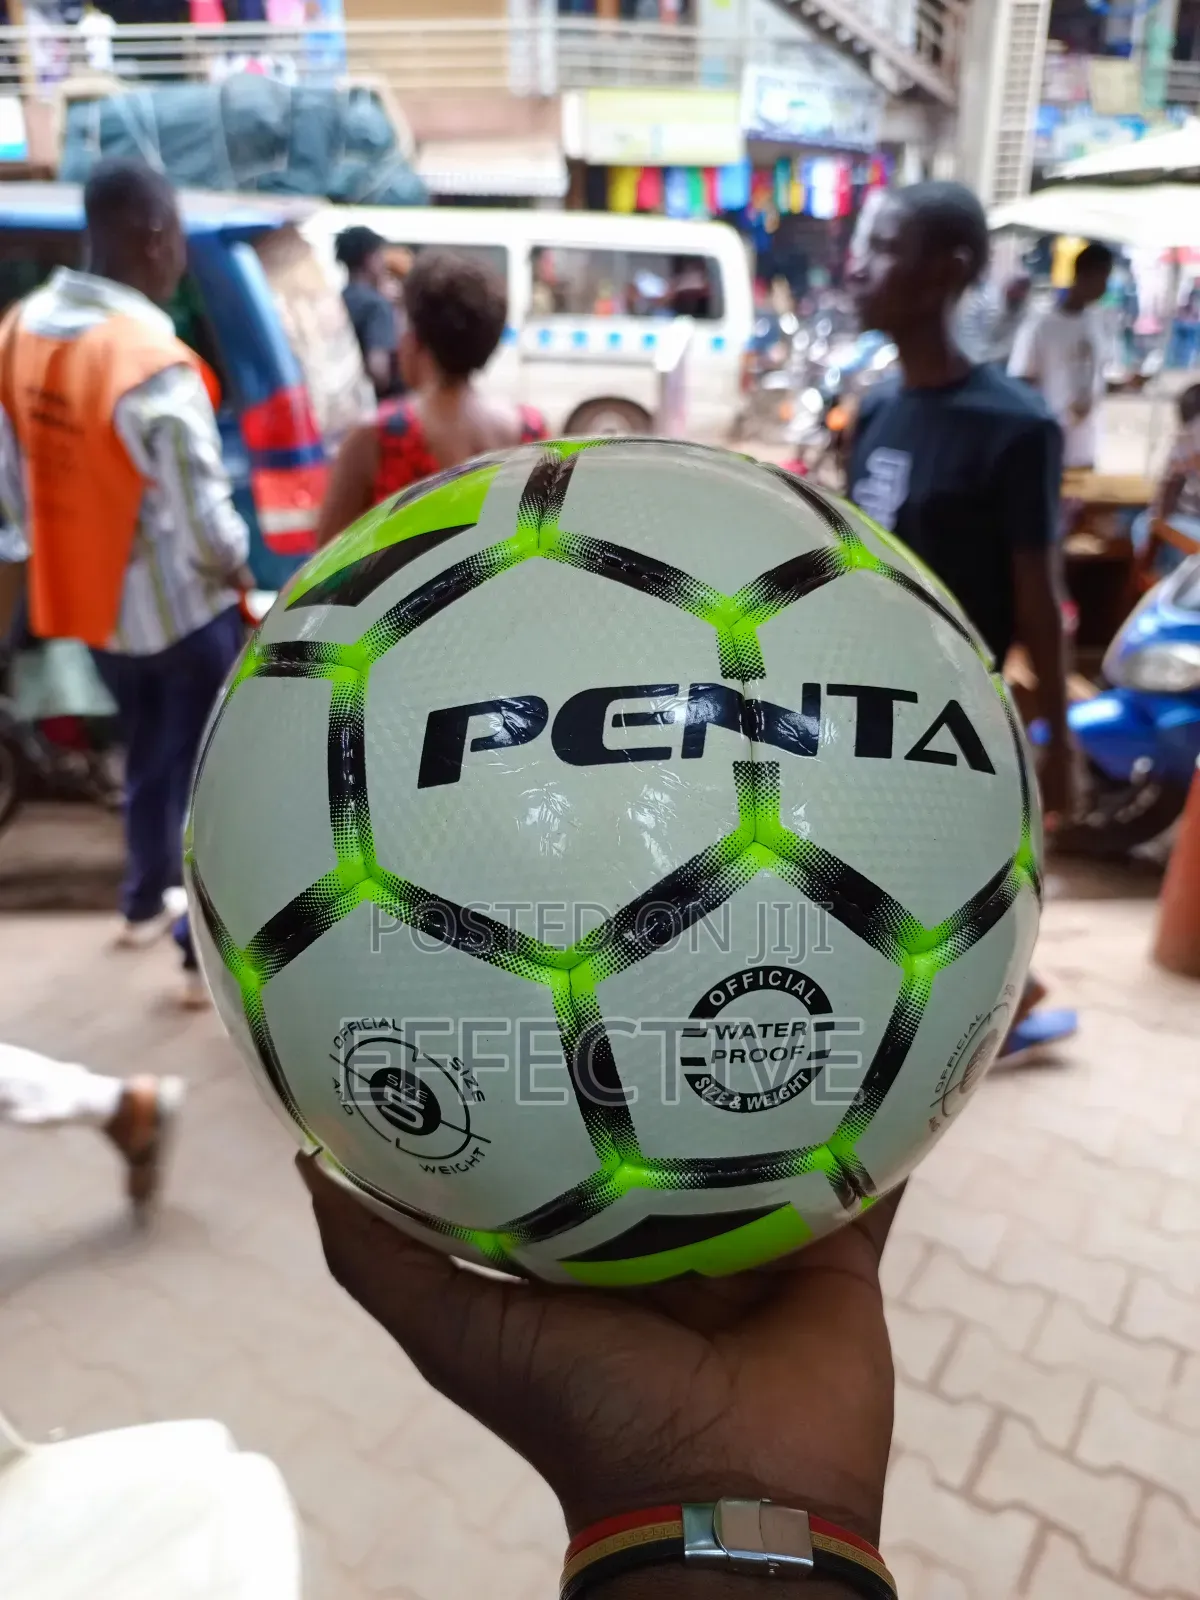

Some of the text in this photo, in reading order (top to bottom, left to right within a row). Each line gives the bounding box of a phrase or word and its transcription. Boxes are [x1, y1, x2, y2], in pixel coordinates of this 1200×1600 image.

[417, 682, 996, 790] PENTA
[709, 970, 817, 1006] OFFICIAL
[332, 1017, 404, 1050] OFFICIAL
[715, 1022, 808, 1040] WATER
[711, 1045, 805, 1064] PROOF
[386, 1073, 429, 1103] SIZE
[450, 1055, 486, 1103] SIZE
[695, 1071, 810, 1111] SIZE & WEIGHT
[331, 1077, 355, 1116] AND
[419, 1146, 486, 1175] WEIGHT
